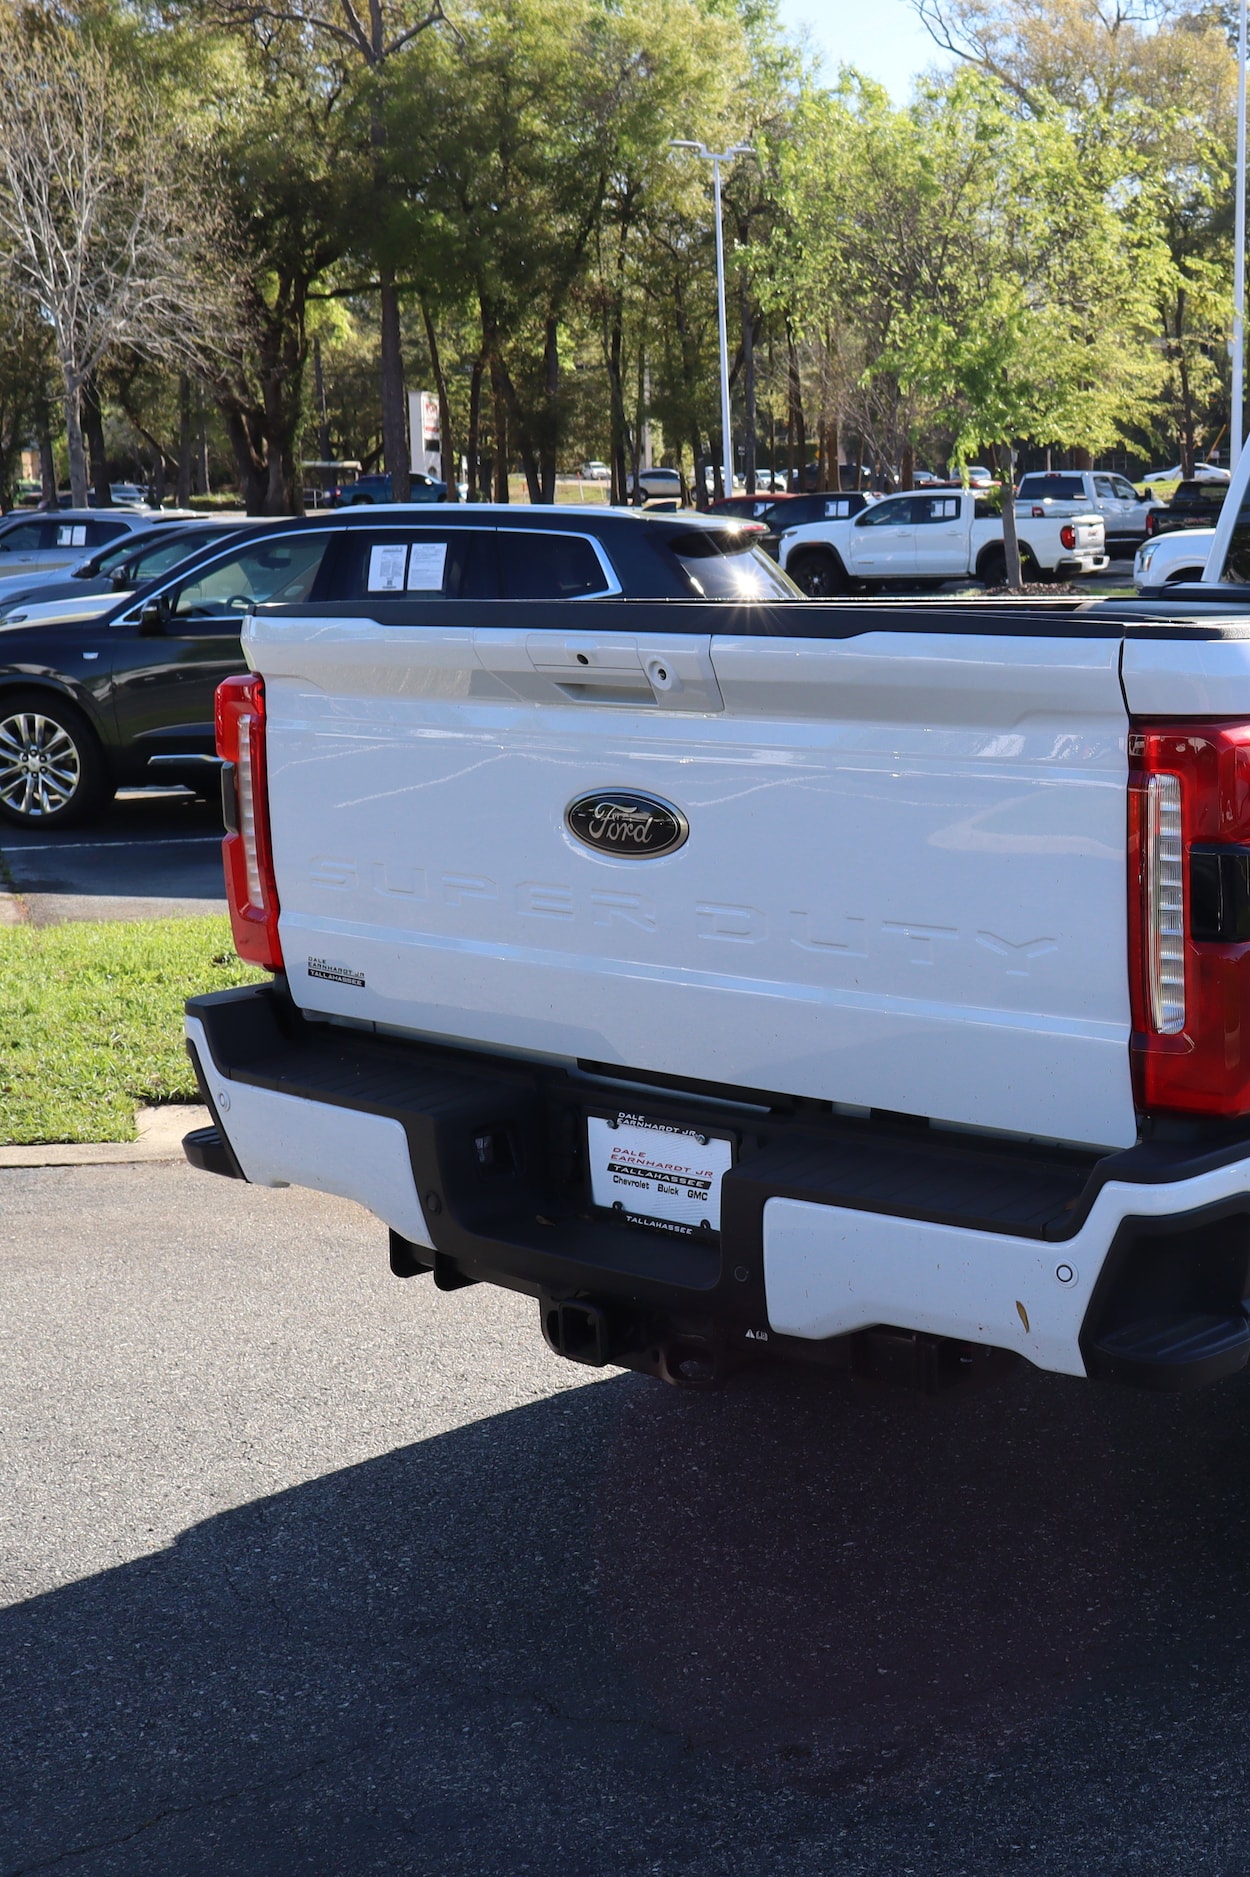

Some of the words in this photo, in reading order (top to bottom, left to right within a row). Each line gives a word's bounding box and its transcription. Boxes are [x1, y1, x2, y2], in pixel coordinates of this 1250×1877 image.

[588, 802, 653, 843] Ford
[308, 855, 657, 933] SUPER
[695, 900, 1059, 977] DUTY
[616, 1118, 680, 1133] EARNHARDT
[618, 1112, 645, 1122] DALE
[612, 1147, 646, 1157] DALE
[610, 1154, 691, 1172] EARNHARDT
[695, 1169, 713, 1178] JR
[613, 1165, 705, 1188] TALLAHASSEE
[613, 1175, 649, 1190] Chevrolet
[657, 1184, 679, 1196] Buick
[687, 1190, 708, 1201] GMC
[626, 1215, 693, 1235] TALLAHASSEE
